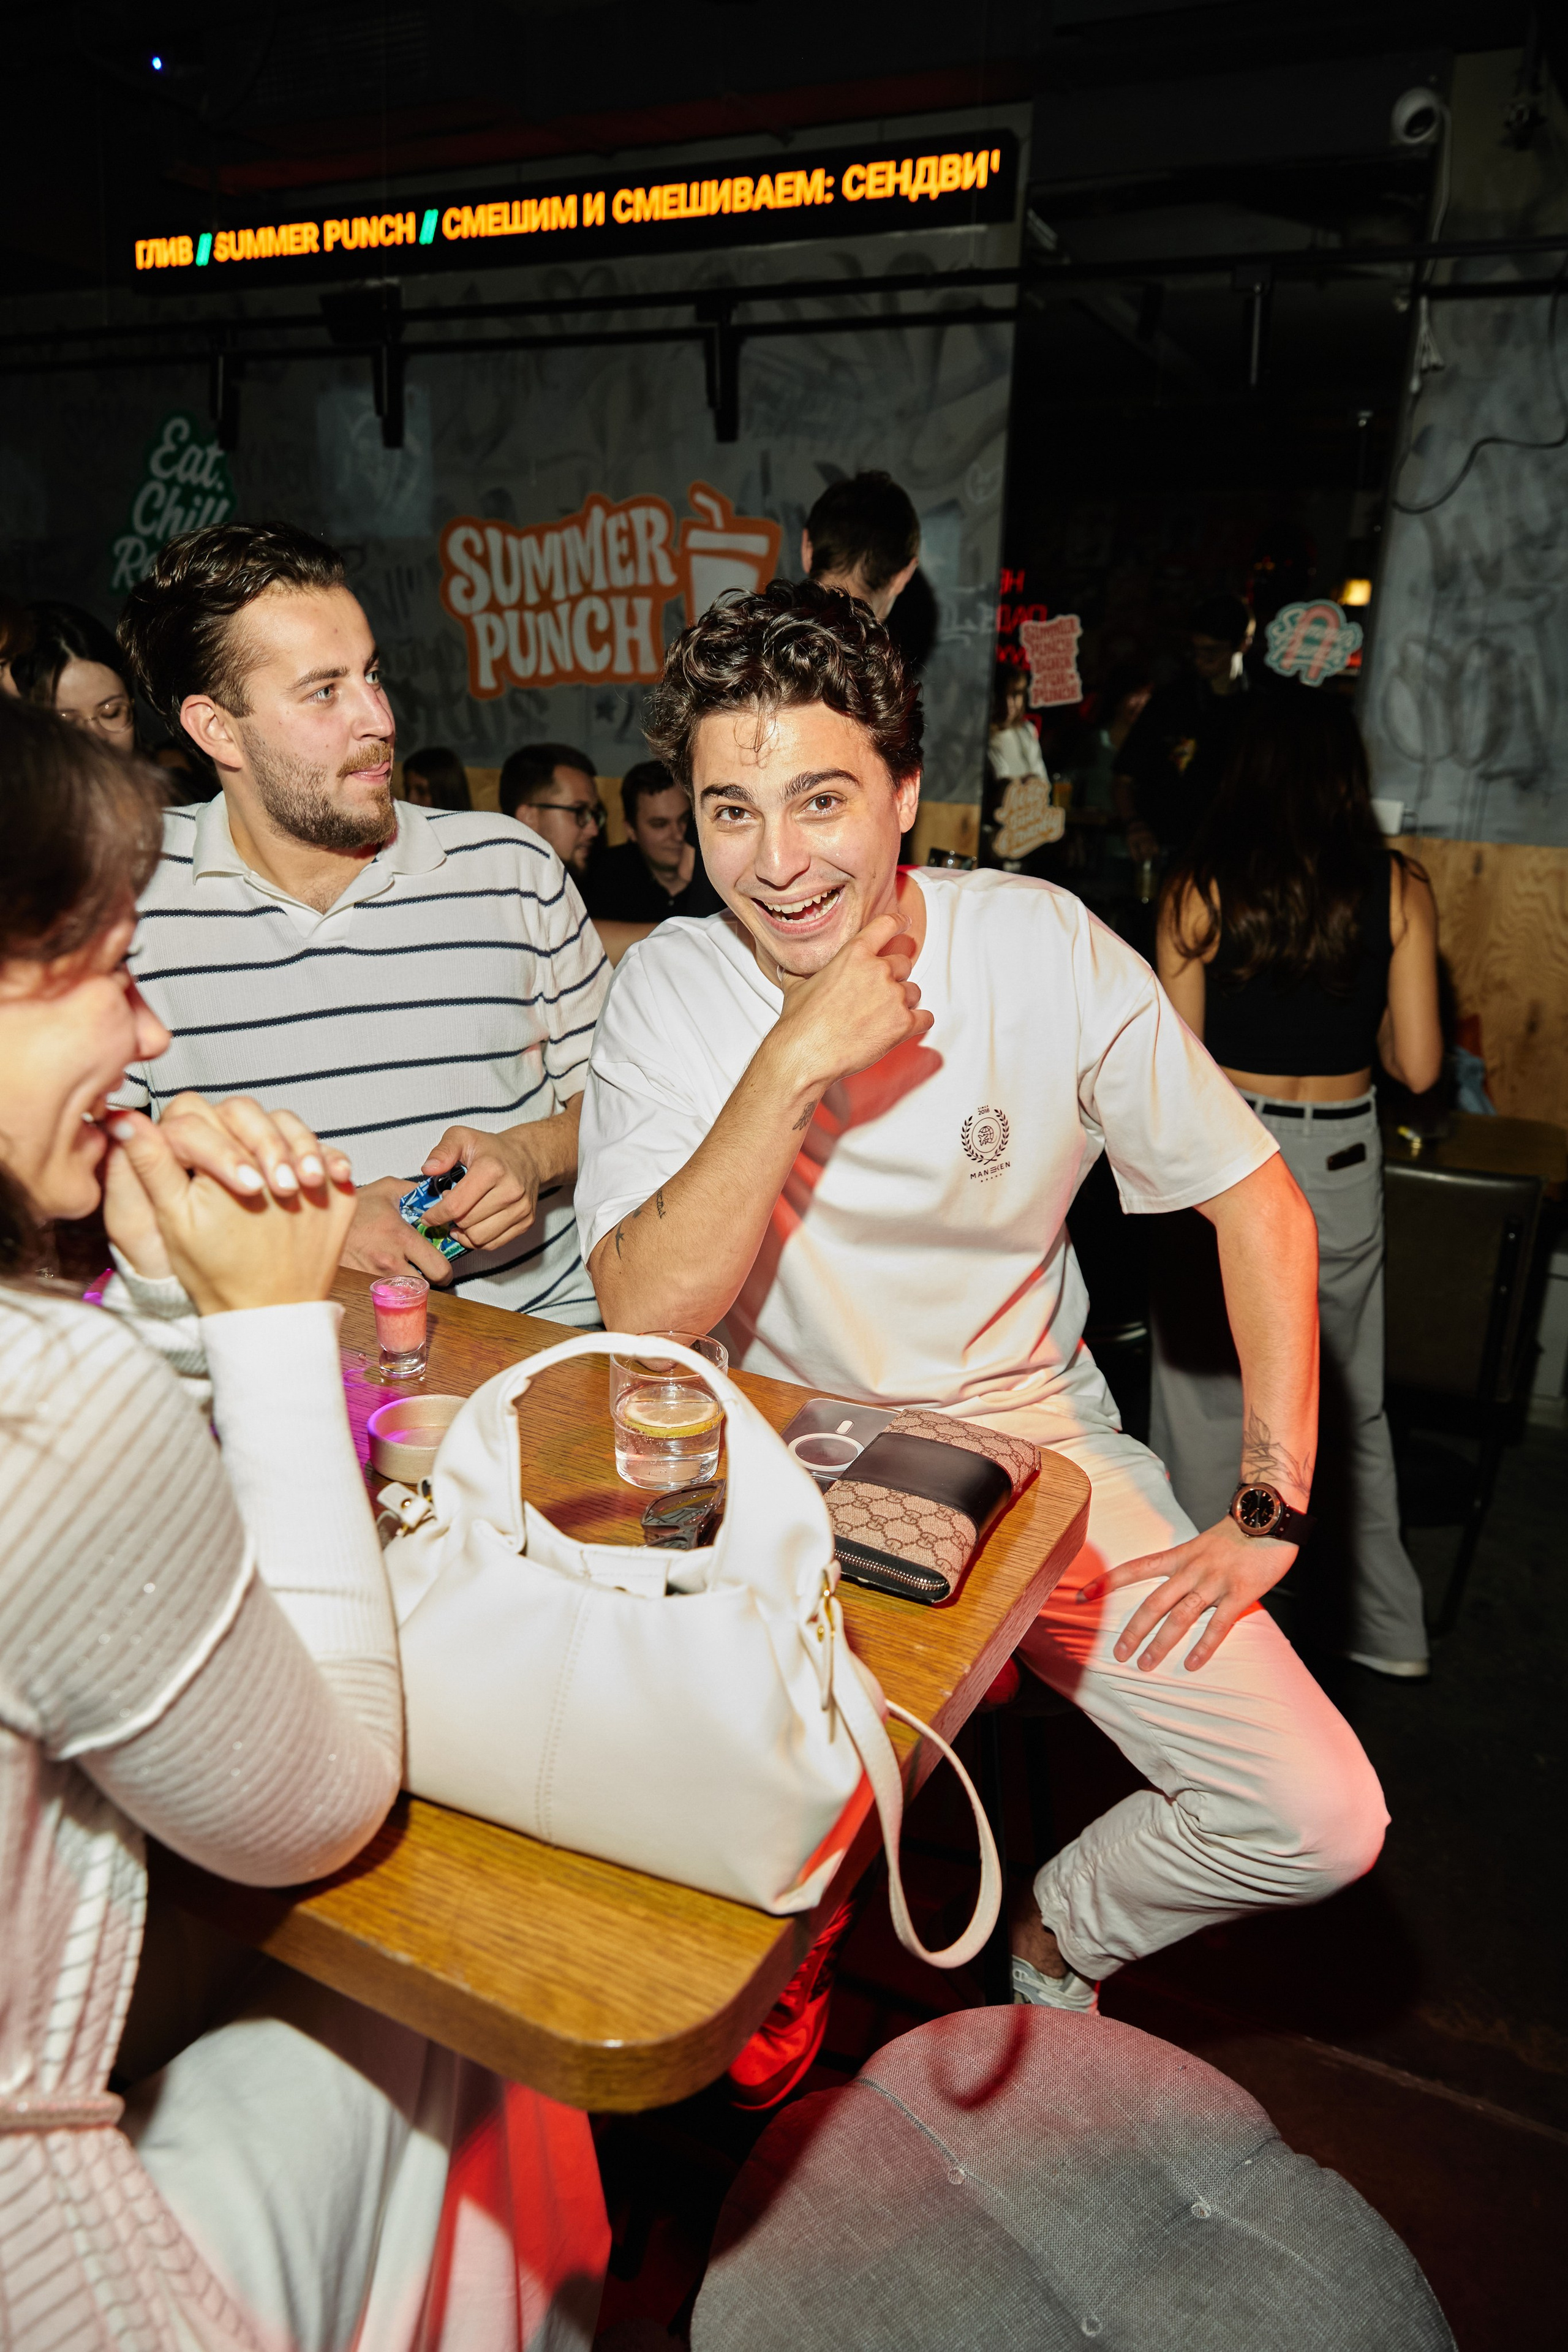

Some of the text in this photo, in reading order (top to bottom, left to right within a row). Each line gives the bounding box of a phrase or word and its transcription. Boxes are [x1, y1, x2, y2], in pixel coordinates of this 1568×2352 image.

[213, 221, 320, 263] SUMMER
[323, 211, 417, 252] PUNCH
[442, 194, 578, 240] СМЕШИМ
[582, 190, 606, 227] И
[612, 168, 835, 224] СМЕШИВАЕМ:
[447, 504, 678, 614] SUMMER
[472, 595, 658, 690] PUNCH
